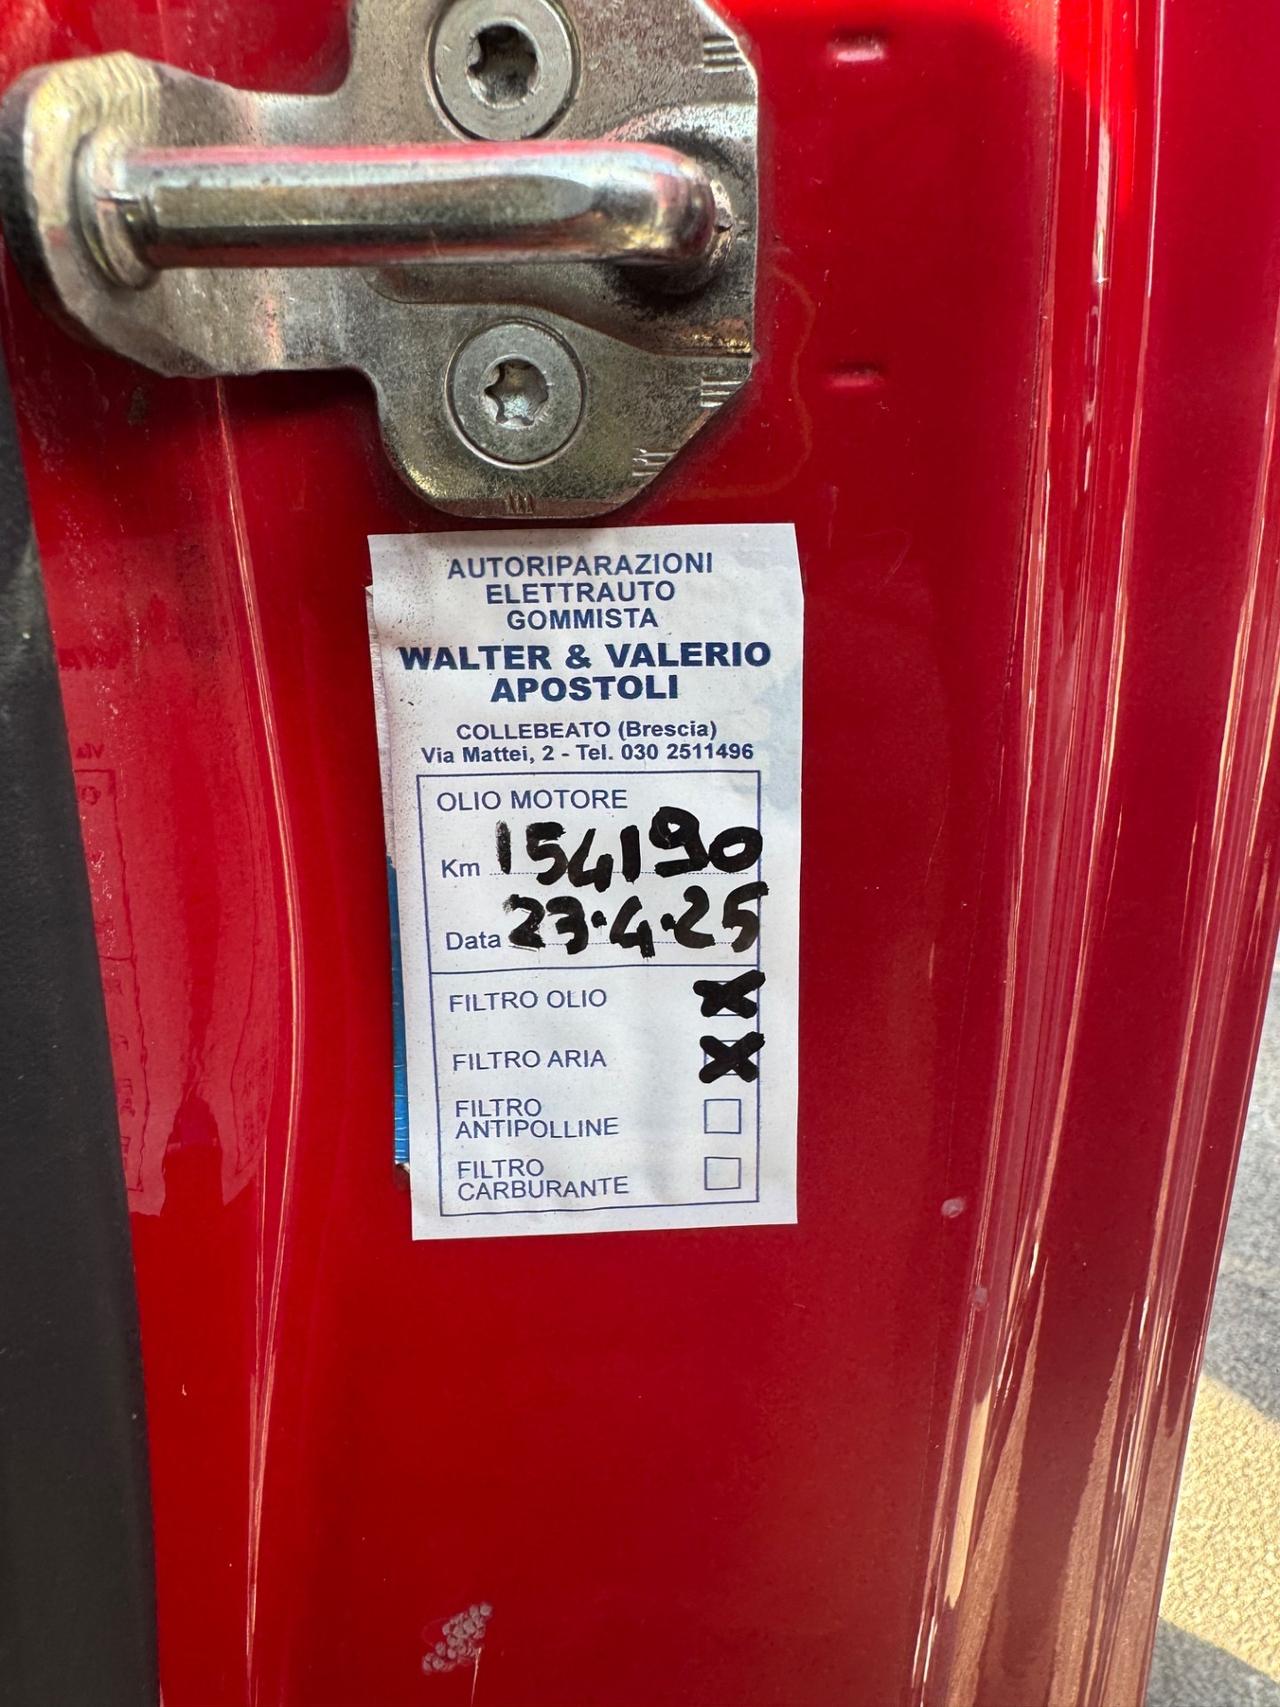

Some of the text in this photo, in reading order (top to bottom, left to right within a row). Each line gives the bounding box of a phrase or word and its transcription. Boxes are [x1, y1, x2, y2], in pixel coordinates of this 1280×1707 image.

[447, 551, 714, 579] AUTORIPARAZIONI
[485, 579, 676, 605] ELETTRAUTO
[506, 607, 659, 631] GOMMISTA
[398, 640, 772, 671] WALTER & VALERIO
[489, 674, 680, 703] APOSTOLI
[456, 719, 718, 741] COLLEBEATO (Brescia)
[421, 746, 455, 764] Via
[462, 746, 536, 766] Mattei,
[541, 745, 556, 762] 2
[575, 744, 614, 762] Tel.
[620, 743, 660, 761] 030
[666, 742, 755, 761] 2511496
[436, 788, 628, 812] OLIO MOTORE
[495, 806, 764, 893] 154190
[441, 858, 481, 879] Km
[445, 931, 501, 951] Data
[448, 988, 608, 1013] FILTRO OLIO
[452, 1048, 607, 1072] FILTRO ARIA
[454, 1097, 542, 1118] FILTRO
[454, 1117, 619, 1140] ANTIPOLLINE
[457, 1158, 545, 1180] FILTRO
[457, 1175, 629, 1201] CARBURANTE
